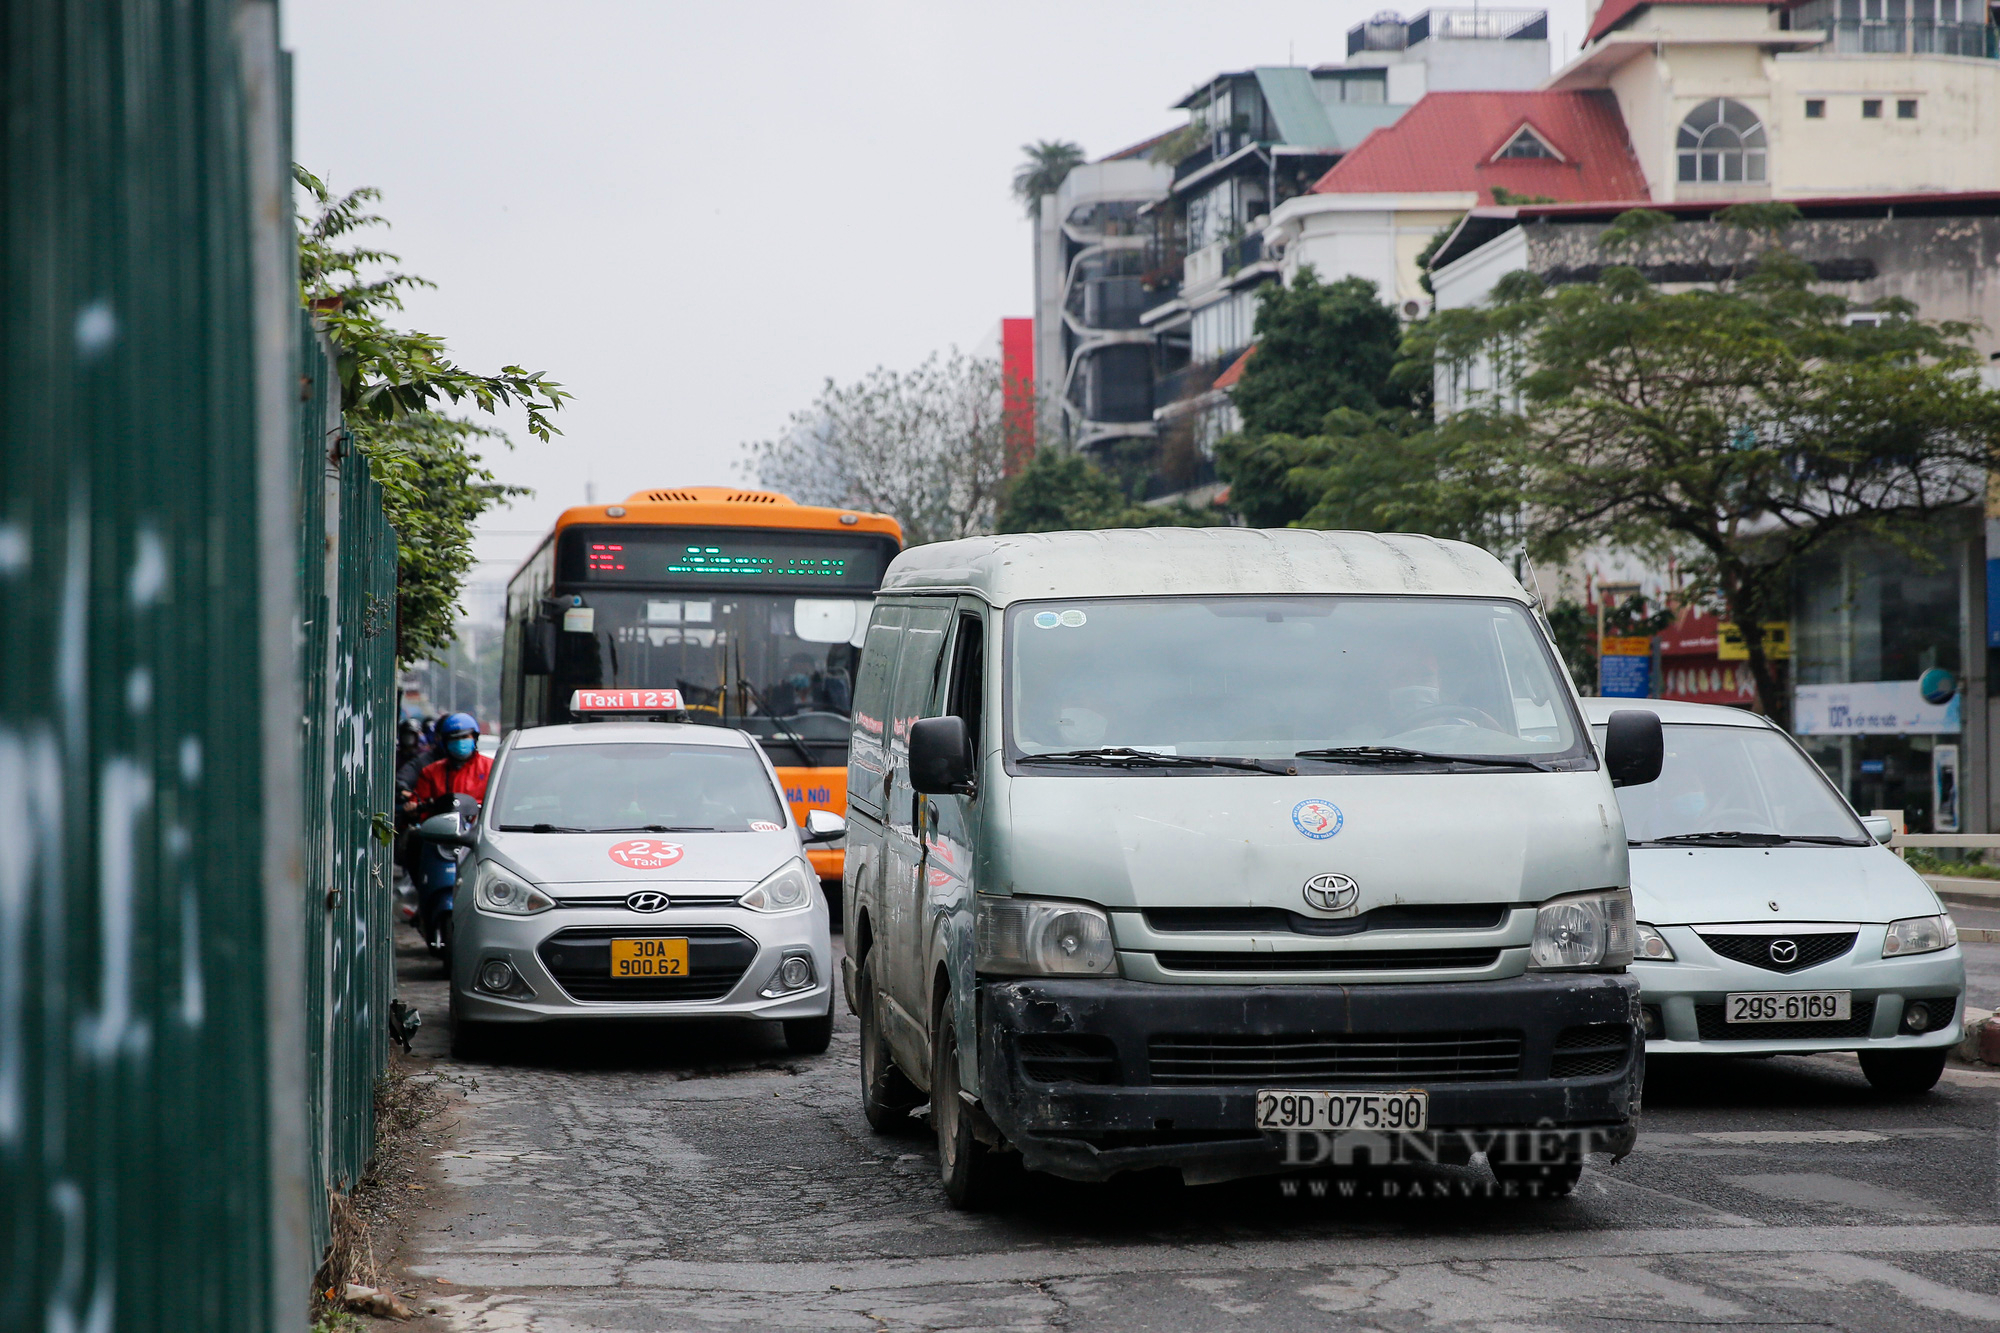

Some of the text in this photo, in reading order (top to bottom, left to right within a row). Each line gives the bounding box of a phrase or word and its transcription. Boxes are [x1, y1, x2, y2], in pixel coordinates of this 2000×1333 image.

[582, 692, 675, 707] Taxi 123
[786, 784, 831, 806] HÀ NỘI
[614, 841, 684, 862] 123
[631, 857, 662, 867] Taxi
[633, 941, 666, 957] 30A
[620, 959, 680, 975] 900.62
[1734, 995, 1837, 1020] 29S-6169
